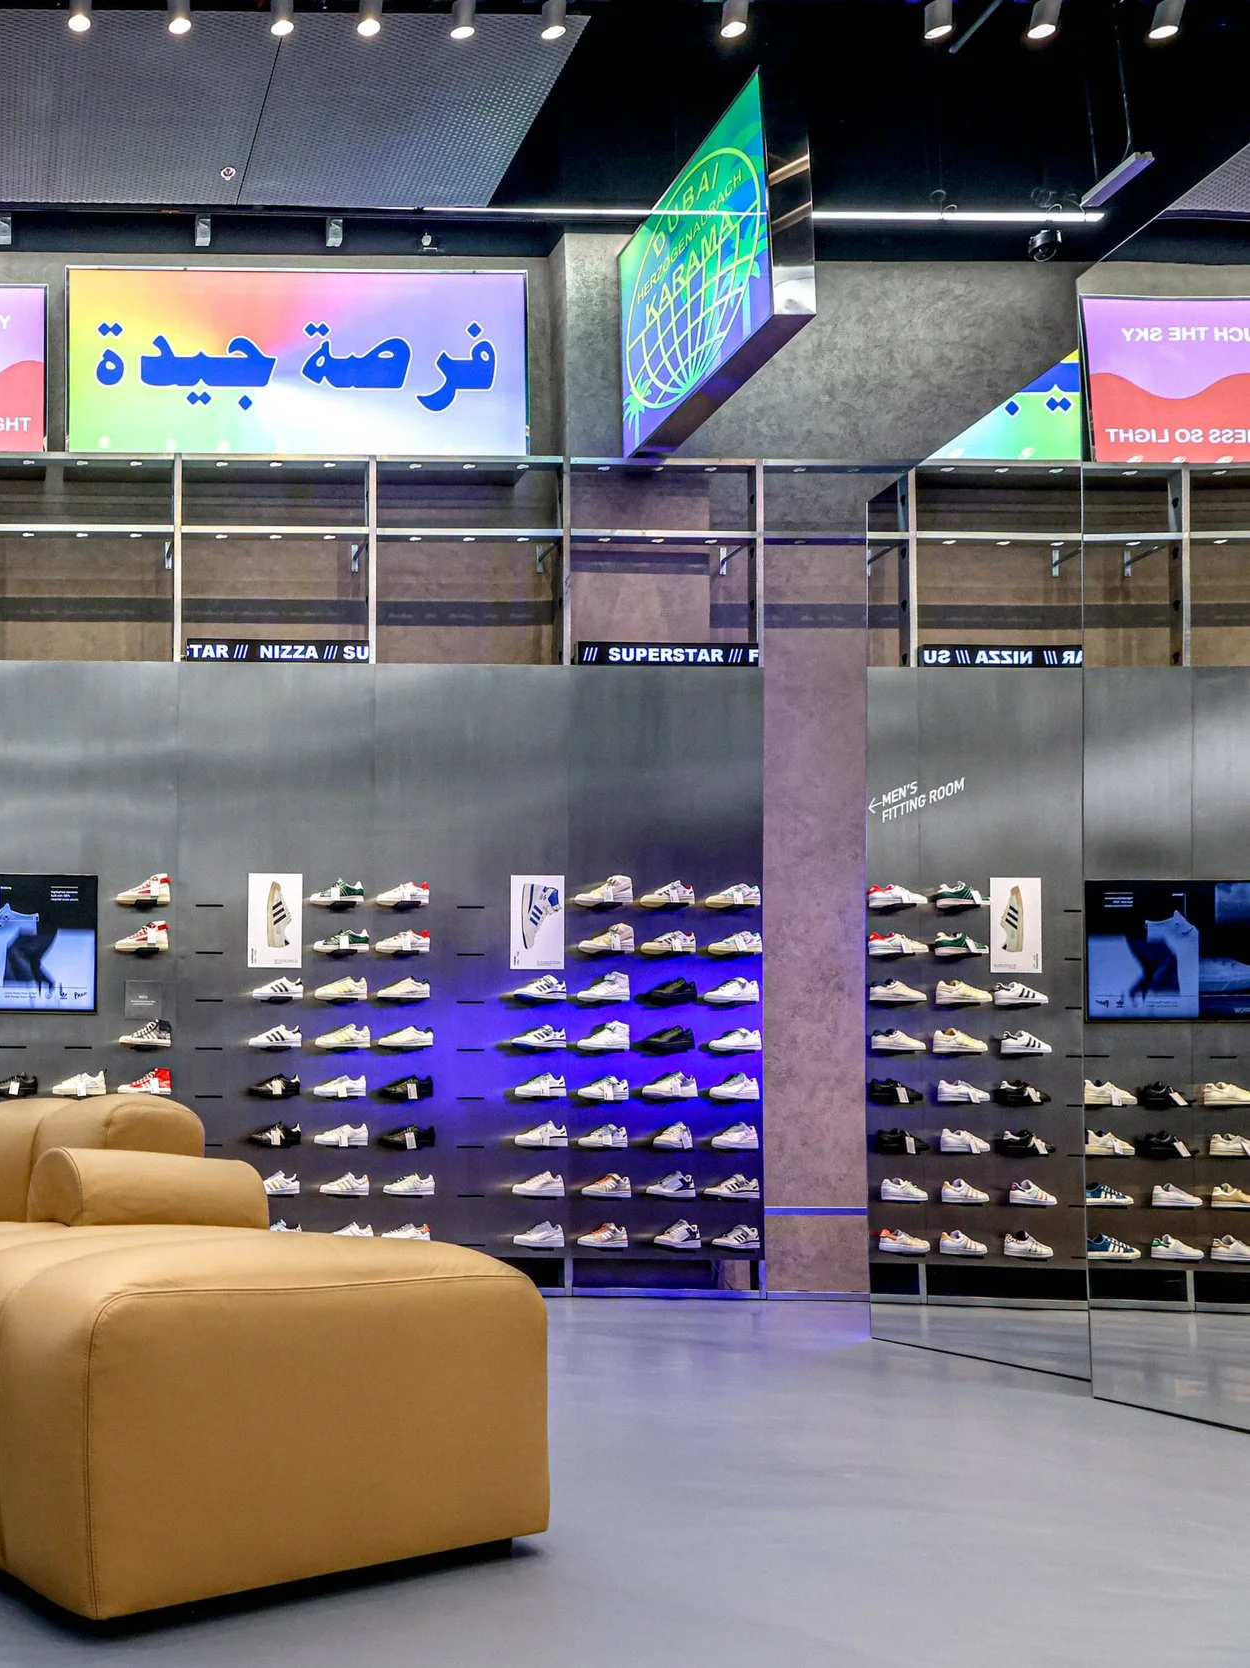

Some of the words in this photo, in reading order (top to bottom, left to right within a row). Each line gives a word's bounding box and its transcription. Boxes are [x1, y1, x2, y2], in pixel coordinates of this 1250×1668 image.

[637, 168, 743, 305] HERZOGENAURACH
[651, 162, 719, 258] DUBAI
[645, 211, 735, 324] KARAMA
[95, 321, 278, 411] جيدة
[300, 320, 498, 412] فرصة
[259, 645, 318, 659] NIZZA
[342, 646, 369, 660] SU
[608, 647, 723, 662] SUPERSTAR
[882, 781, 918, 807] MEN'S
[882, 794, 926, 823] FITTING
[929, 777, 965, 804] ROOM
